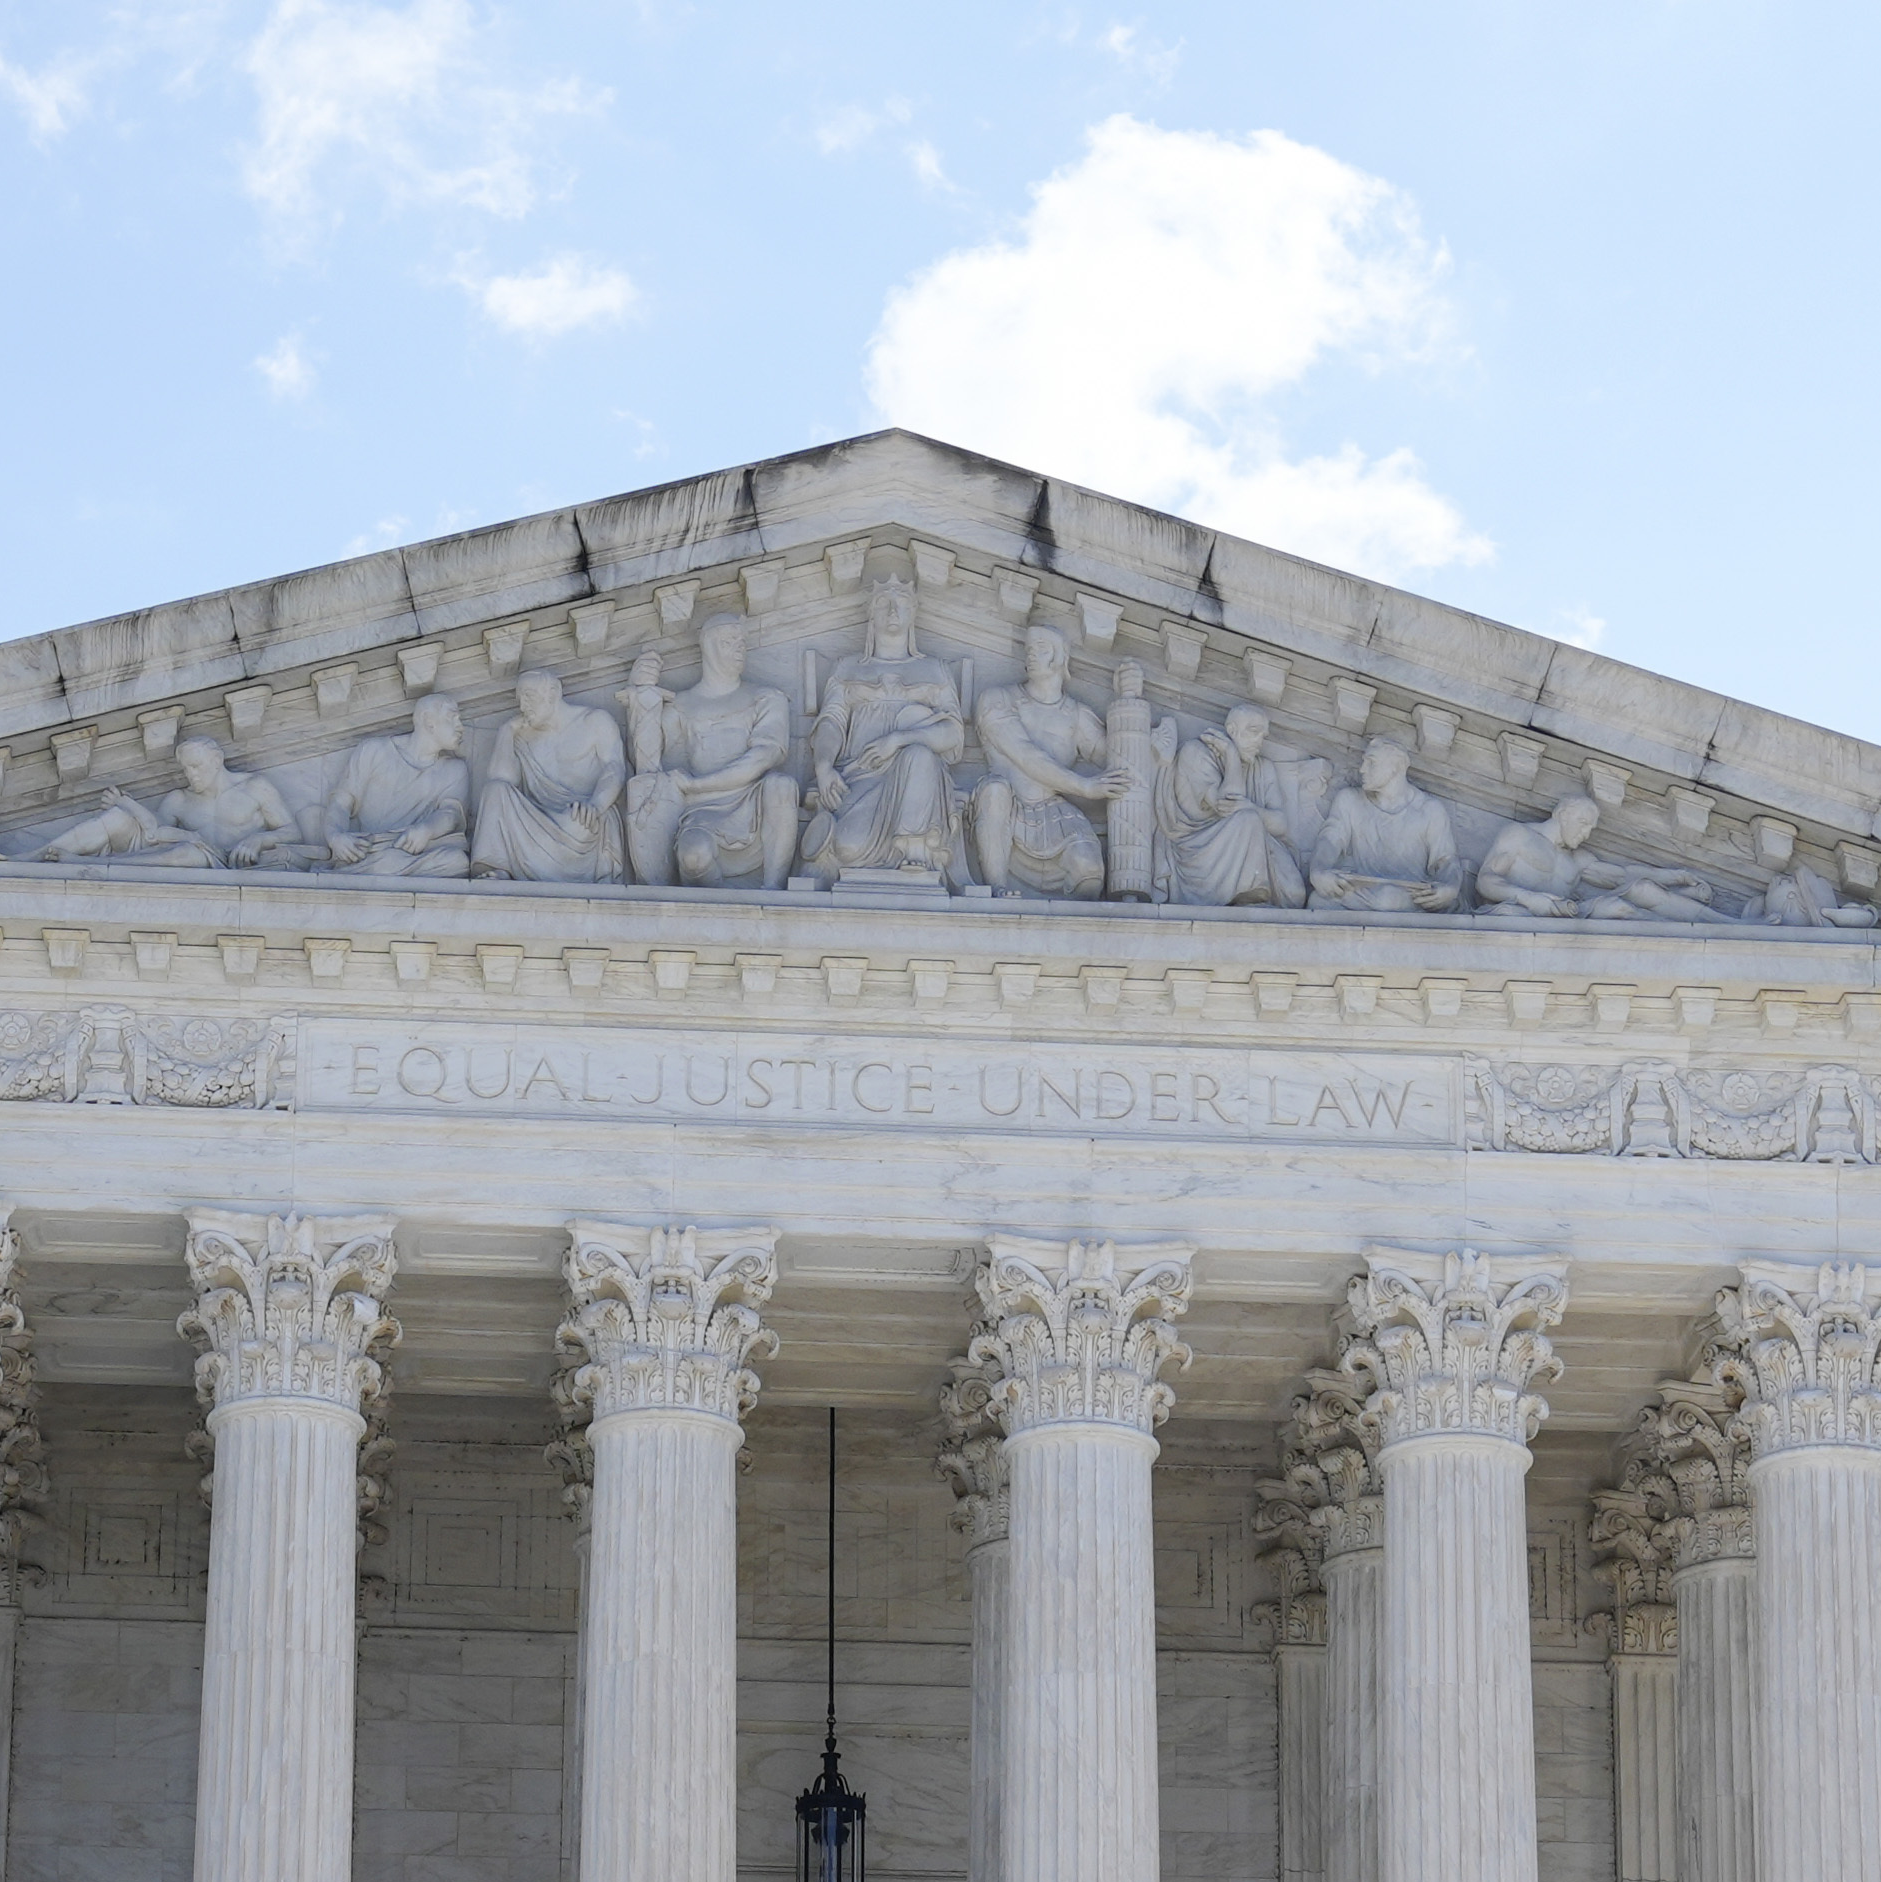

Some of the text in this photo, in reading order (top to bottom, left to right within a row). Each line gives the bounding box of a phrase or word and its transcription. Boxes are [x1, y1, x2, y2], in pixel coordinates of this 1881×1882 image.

[349, 1044, 1415, 1129] EQUAL JUSTICE UNDER LAW
